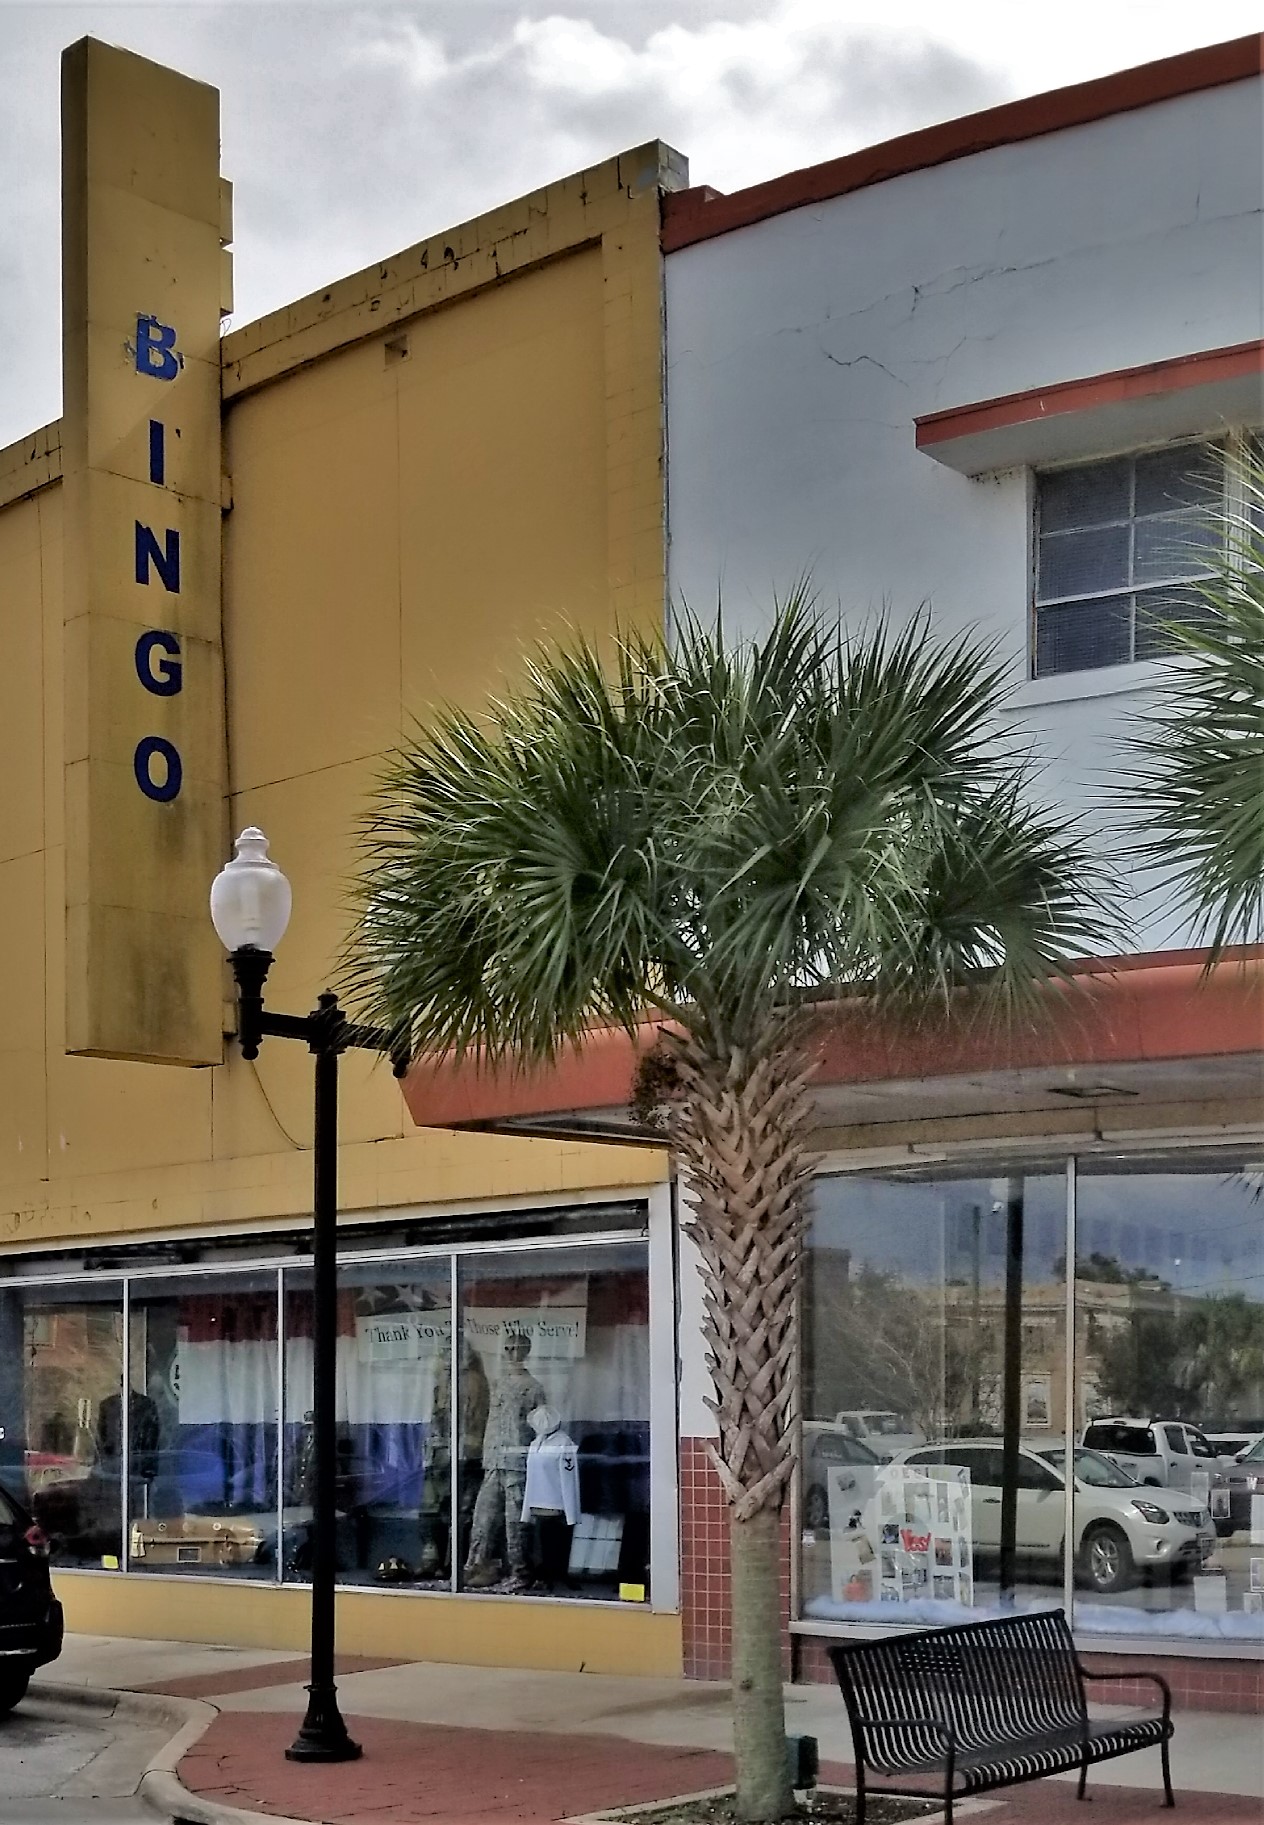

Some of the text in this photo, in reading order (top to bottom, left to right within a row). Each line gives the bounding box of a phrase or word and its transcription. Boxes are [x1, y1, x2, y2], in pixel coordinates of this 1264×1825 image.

[133, 311, 183, 803] BINGO
[365, 1326, 409, 1344] Thank
[466, 1318, 501, 1336] Those
[502, 1319, 534, 1338] Who
[537, 1320, 580, 1338] Serve!
